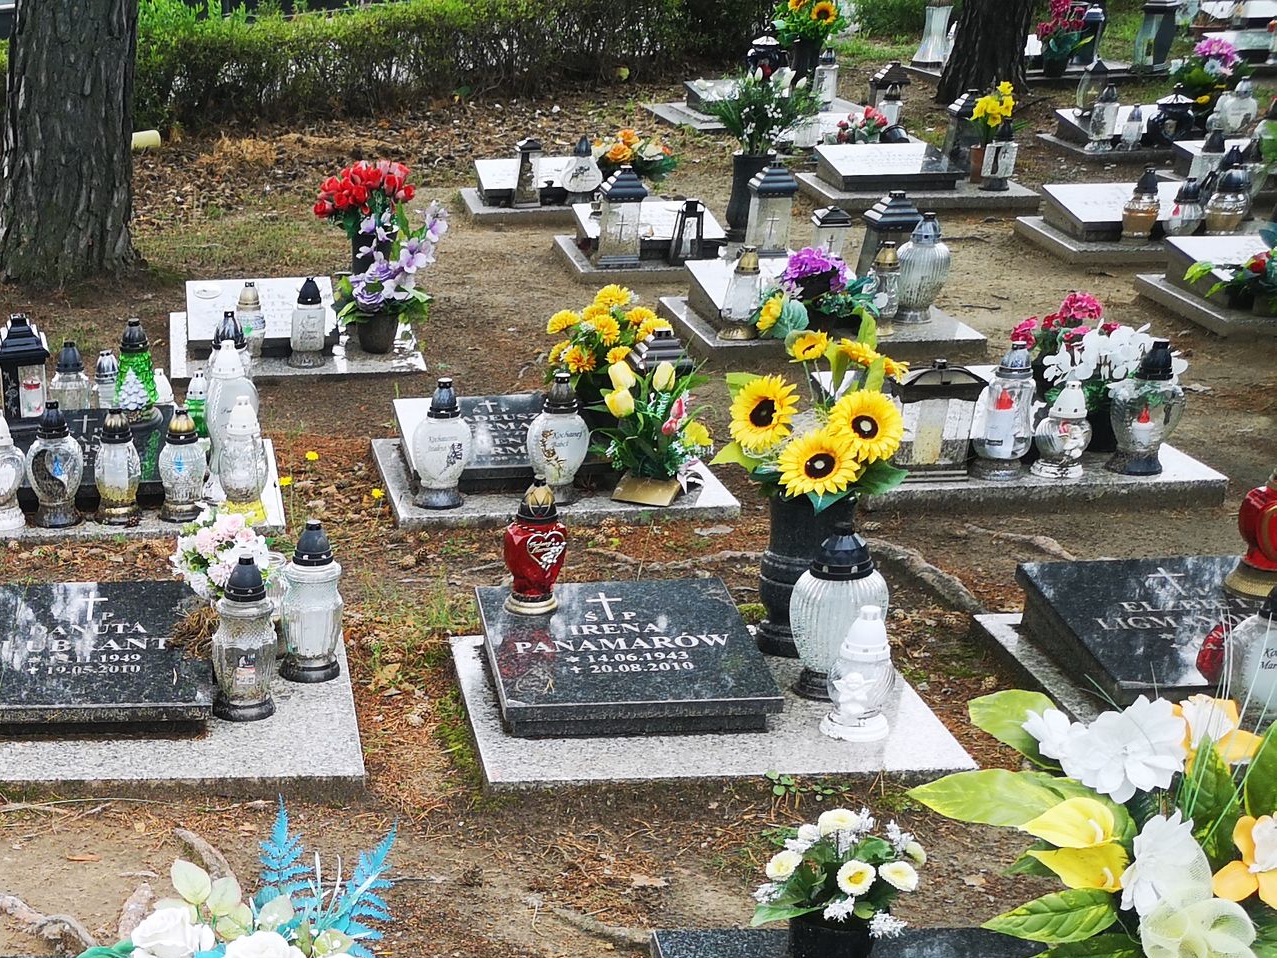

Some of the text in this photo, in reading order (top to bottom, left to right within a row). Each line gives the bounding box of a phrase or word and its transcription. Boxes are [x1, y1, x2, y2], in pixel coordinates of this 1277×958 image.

[584, 611, 637, 622] Ś P
[570, 622, 663, 636] IRENA
[514, 632, 730, 654] PANAMARÓW
[587, 651, 690, 664] 14.06.1943
[46, 664, 141, 675] 19.05.2010
[590, 661, 695, 674] 20.08.2010
